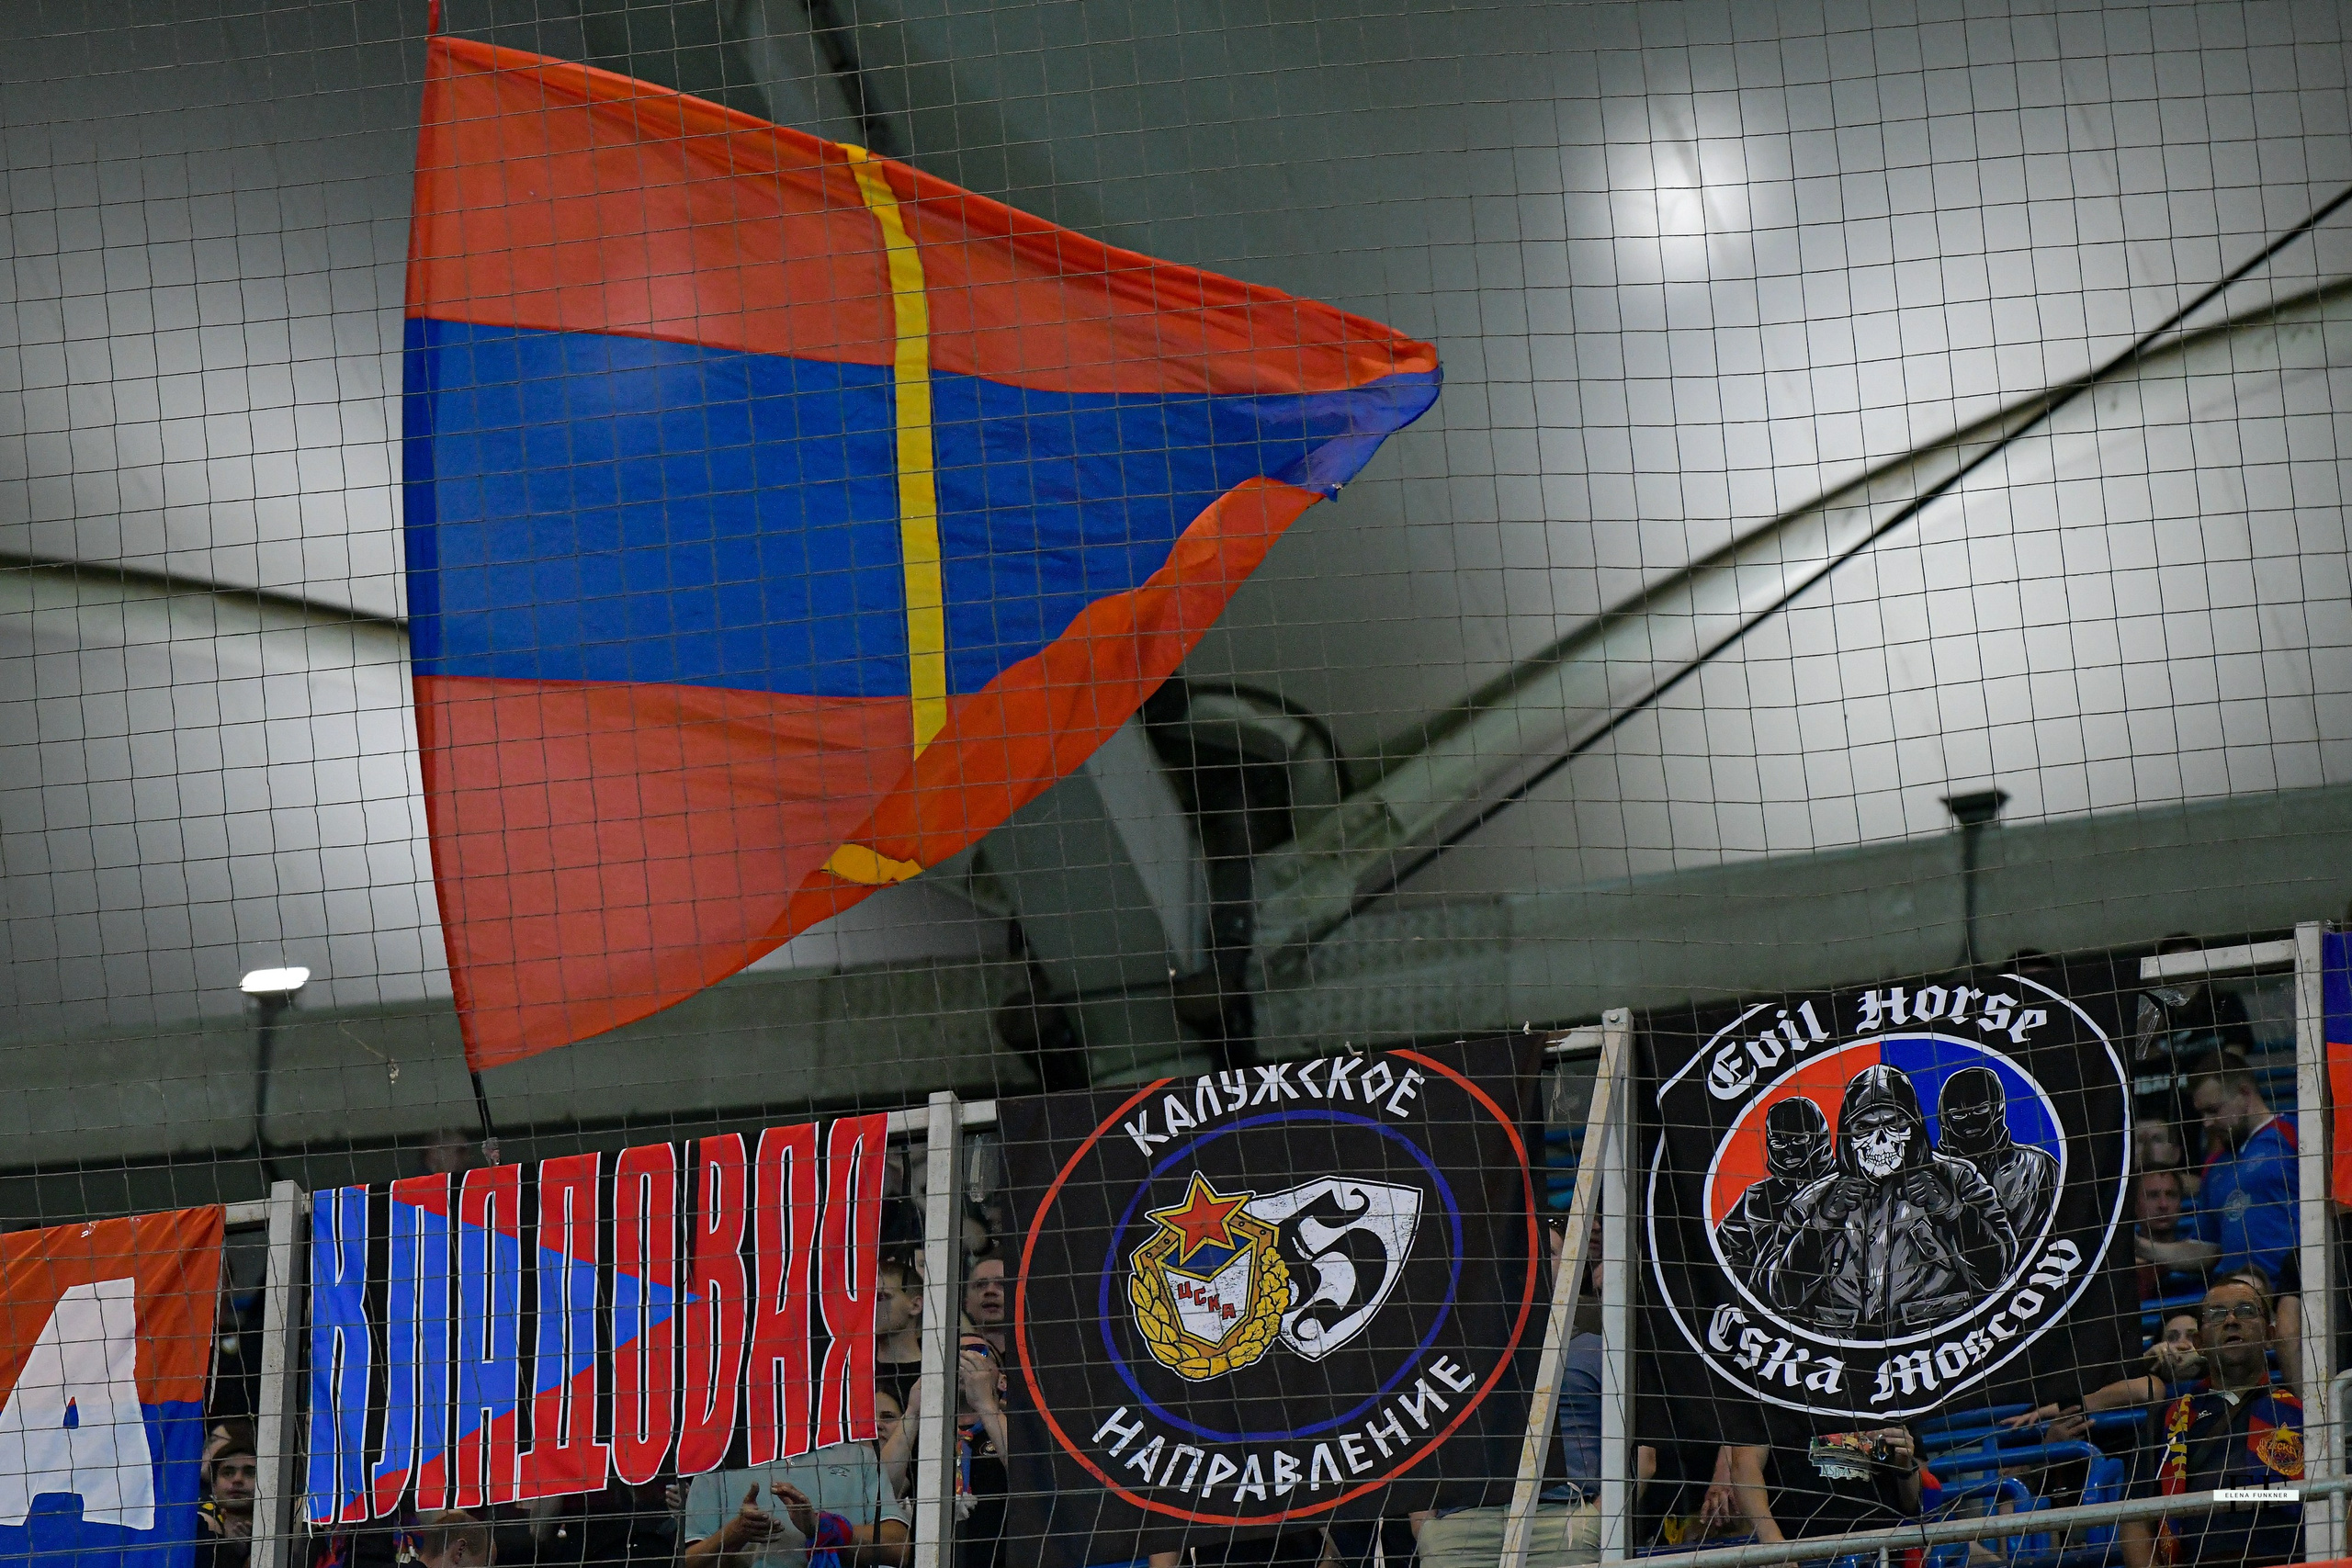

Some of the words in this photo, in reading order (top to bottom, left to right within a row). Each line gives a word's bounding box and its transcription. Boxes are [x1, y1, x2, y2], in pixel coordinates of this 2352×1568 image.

[1124, 1056, 1425, 1156] КАЛУЖСКОЕ
[1708, 1000, 1830, 1100] Evil
[1856, 985, 2048, 1042] Horse
[306, 1112, 889, 1525] КЛАДОВАЯ
[1178, 1281, 1235, 1320] ЦСКА
[1870, 1239, 2083, 1405] Moscow
[1091, 1355, 1476, 1502] НАПРАВЛЕНИЕ
